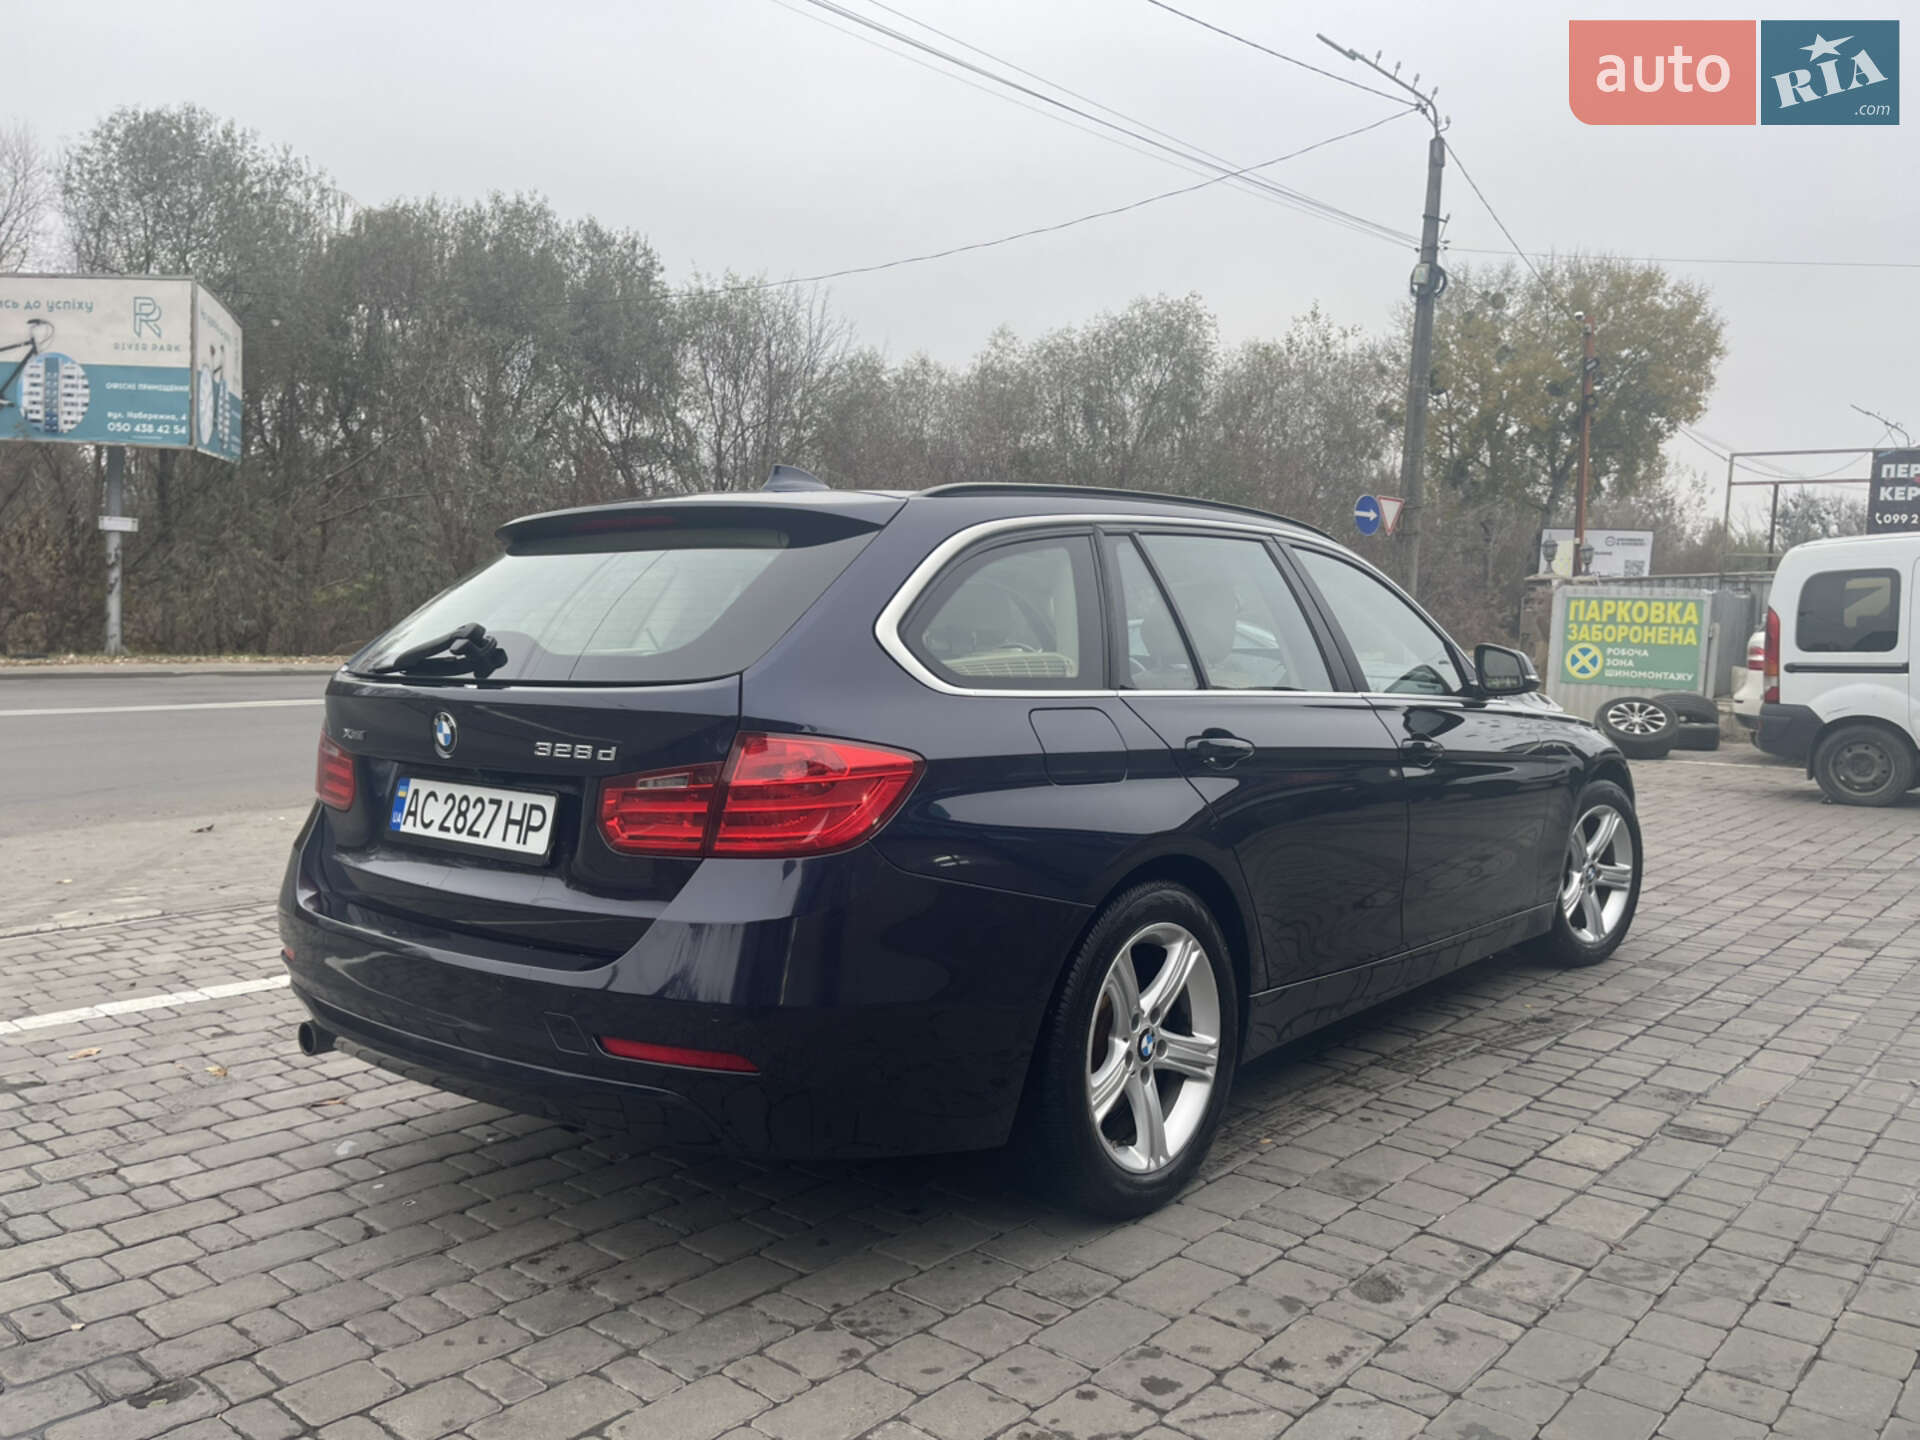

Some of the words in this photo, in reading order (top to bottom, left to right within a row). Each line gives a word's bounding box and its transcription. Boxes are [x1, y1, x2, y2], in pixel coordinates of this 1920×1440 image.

[24, 300, 41, 310] до
[47, 300, 94, 313] успіху
[113, 342, 147, 351] RIVER
[151, 343, 181, 352] PARK
[107, 422, 131, 432] 050
[157, 424, 170, 434] 42
[173, 424, 187, 434] 54
[1883, 513, 1908, 524] 099
[1569, 600, 1699, 624] ПАРКОВКА
[1567, 624, 1698, 645] ЗАБОРОНЕНА
[1606, 647, 1649, 657] РОБОЧА
[1605, 658, 1634, 667] ЗОНА
[1604, 669, 1695, 681] ШИНОМОНТАЖУ
